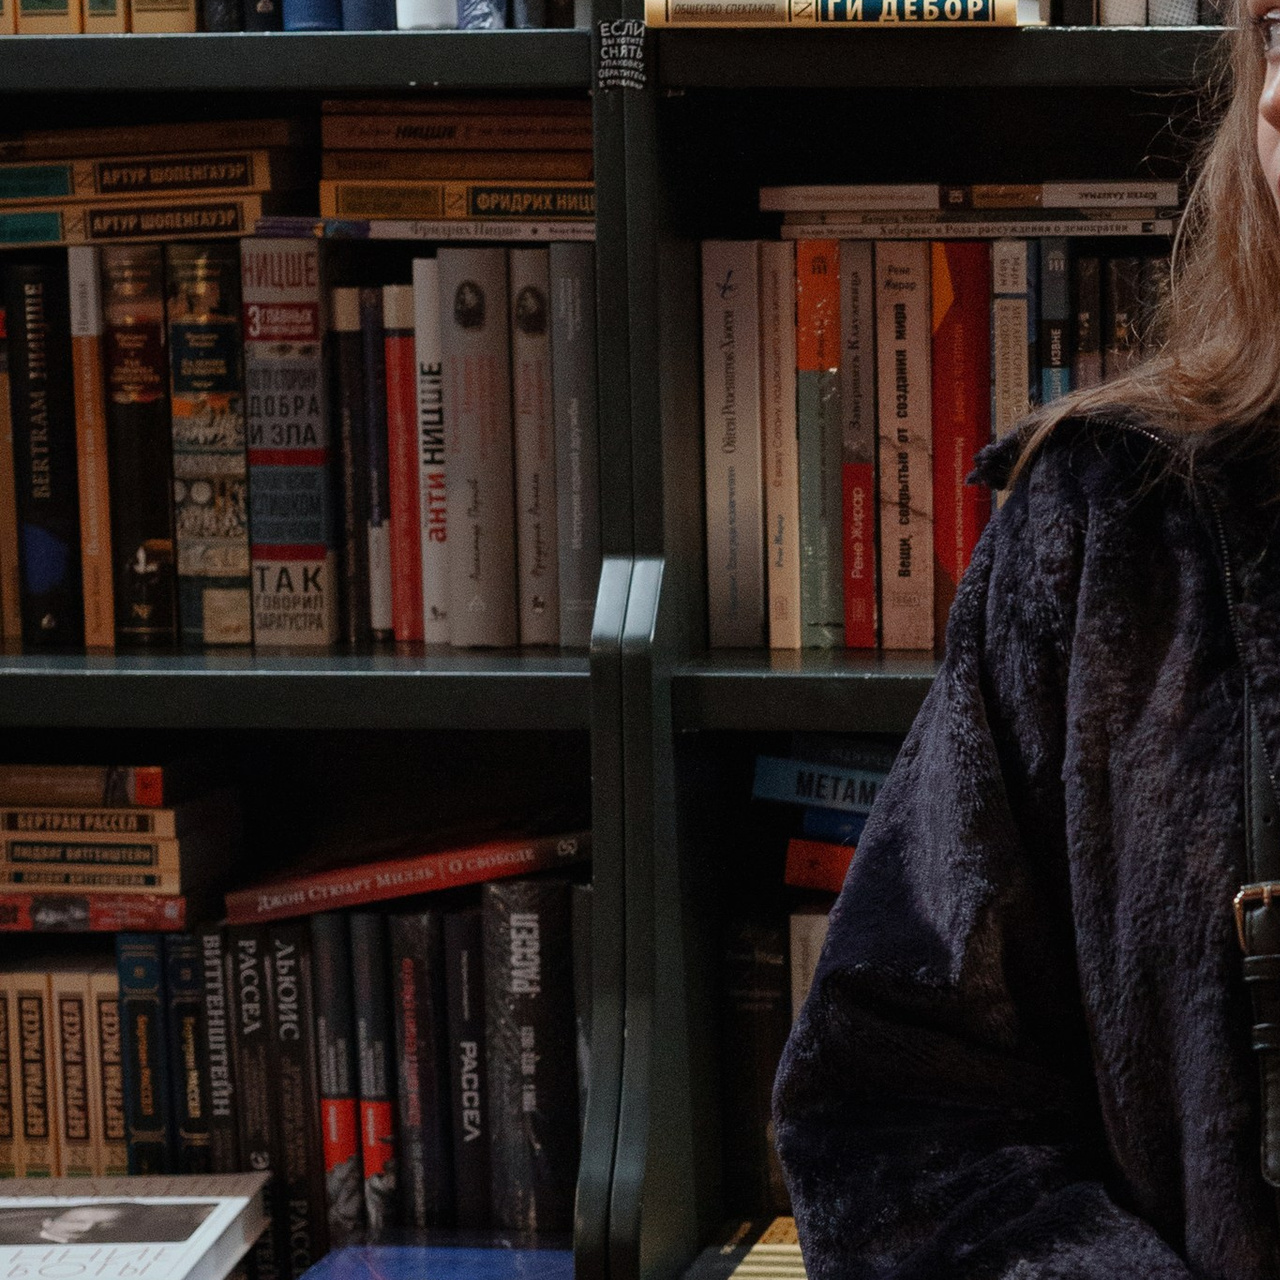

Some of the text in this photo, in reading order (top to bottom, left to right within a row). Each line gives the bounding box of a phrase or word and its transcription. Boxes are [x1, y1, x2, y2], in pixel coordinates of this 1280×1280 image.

[242, 251, 315, 287] НИЦШЕ
[249, 395, 319, 418] ДОБРА
[249, 423, 317, 446] И ЗЛА
[421, 362, 448, 543] анти НИЦШЕ
[254, 566, 323, 593] ТАК
[203, 934, 233, 1117] ВИТГЕНШТЕЙН
[237, 939, 262, 1035] РАССЕЛ
[276, 940, 300, 1041] ЛЬЮИС
[460, 1041, 483, 1142] РАССЕЛ
